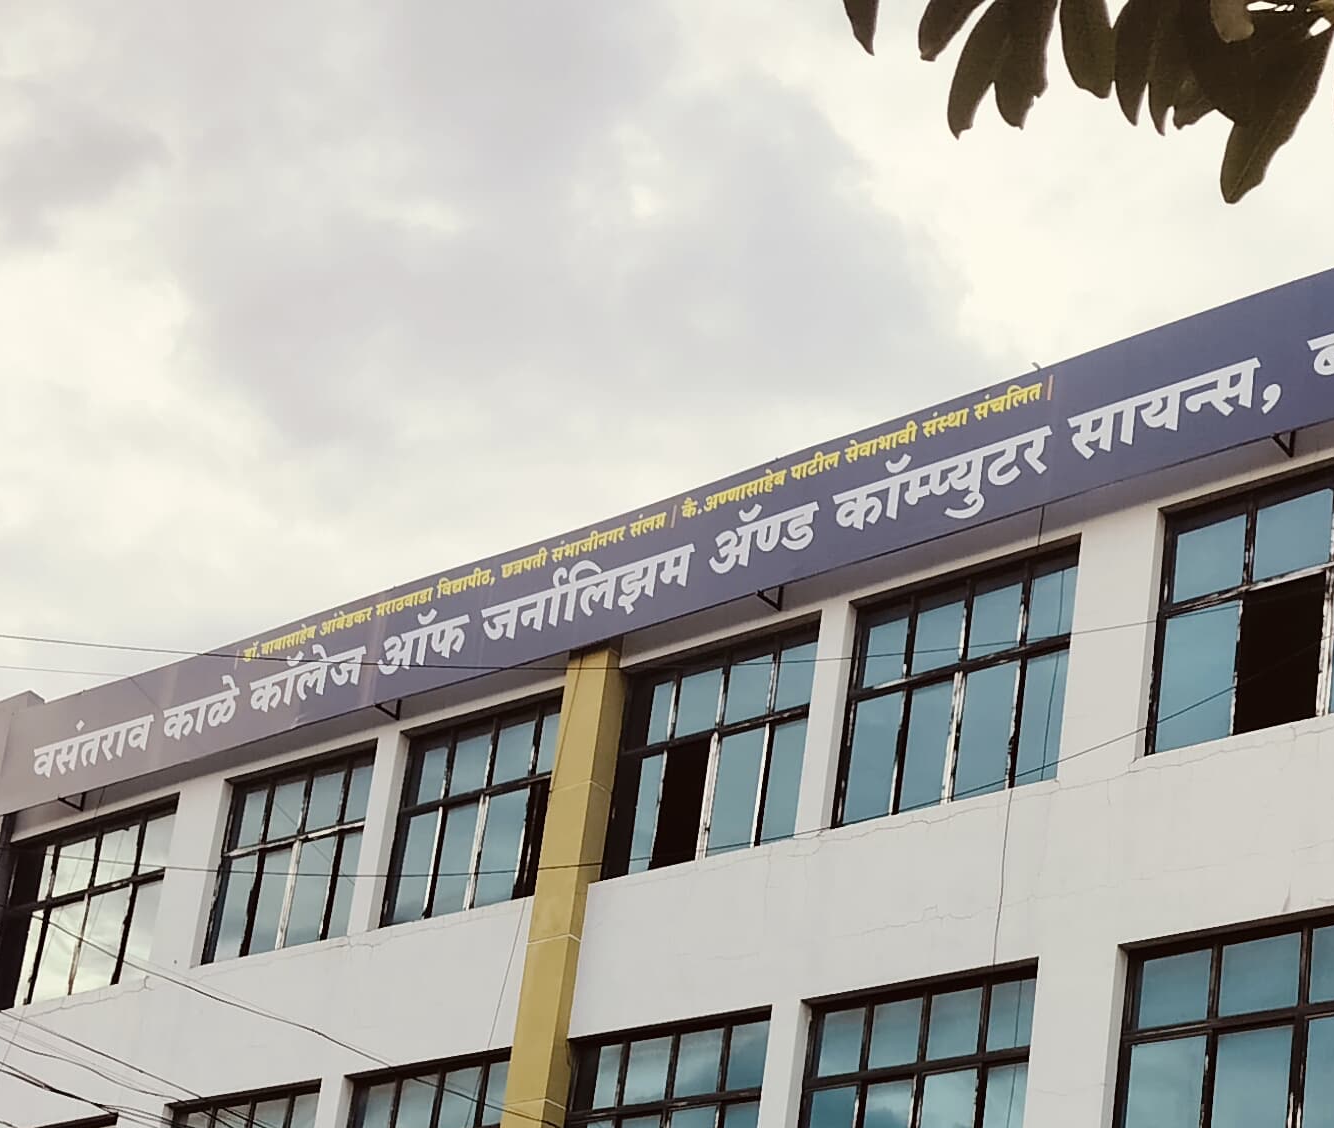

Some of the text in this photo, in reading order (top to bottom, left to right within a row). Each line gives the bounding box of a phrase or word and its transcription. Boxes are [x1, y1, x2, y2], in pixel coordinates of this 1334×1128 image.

[790, 449, 840, 480] पाटील
[844, 421, 917, 463] सेवाभावी
[923, 411, 969, 437] संस्था
[974, 382, 1042, 420] संचलित
[32, 714, 155, 778] वसंतराव
[162, 676, 238, 741] काळे
[249, 644, 367, 714] कॉलेज
[376, 608, 470, 676] ऑफ
[481, 542, 697, 640] जर्नालिझम
[833, 424, 1052, 519] कॉम्प्युटर
[1068, 356, 1282, 459] सायन्स,
[376, 587, 433, 616] मराठवाडा
[551, 526, 625, 562] संभाजीनगर
